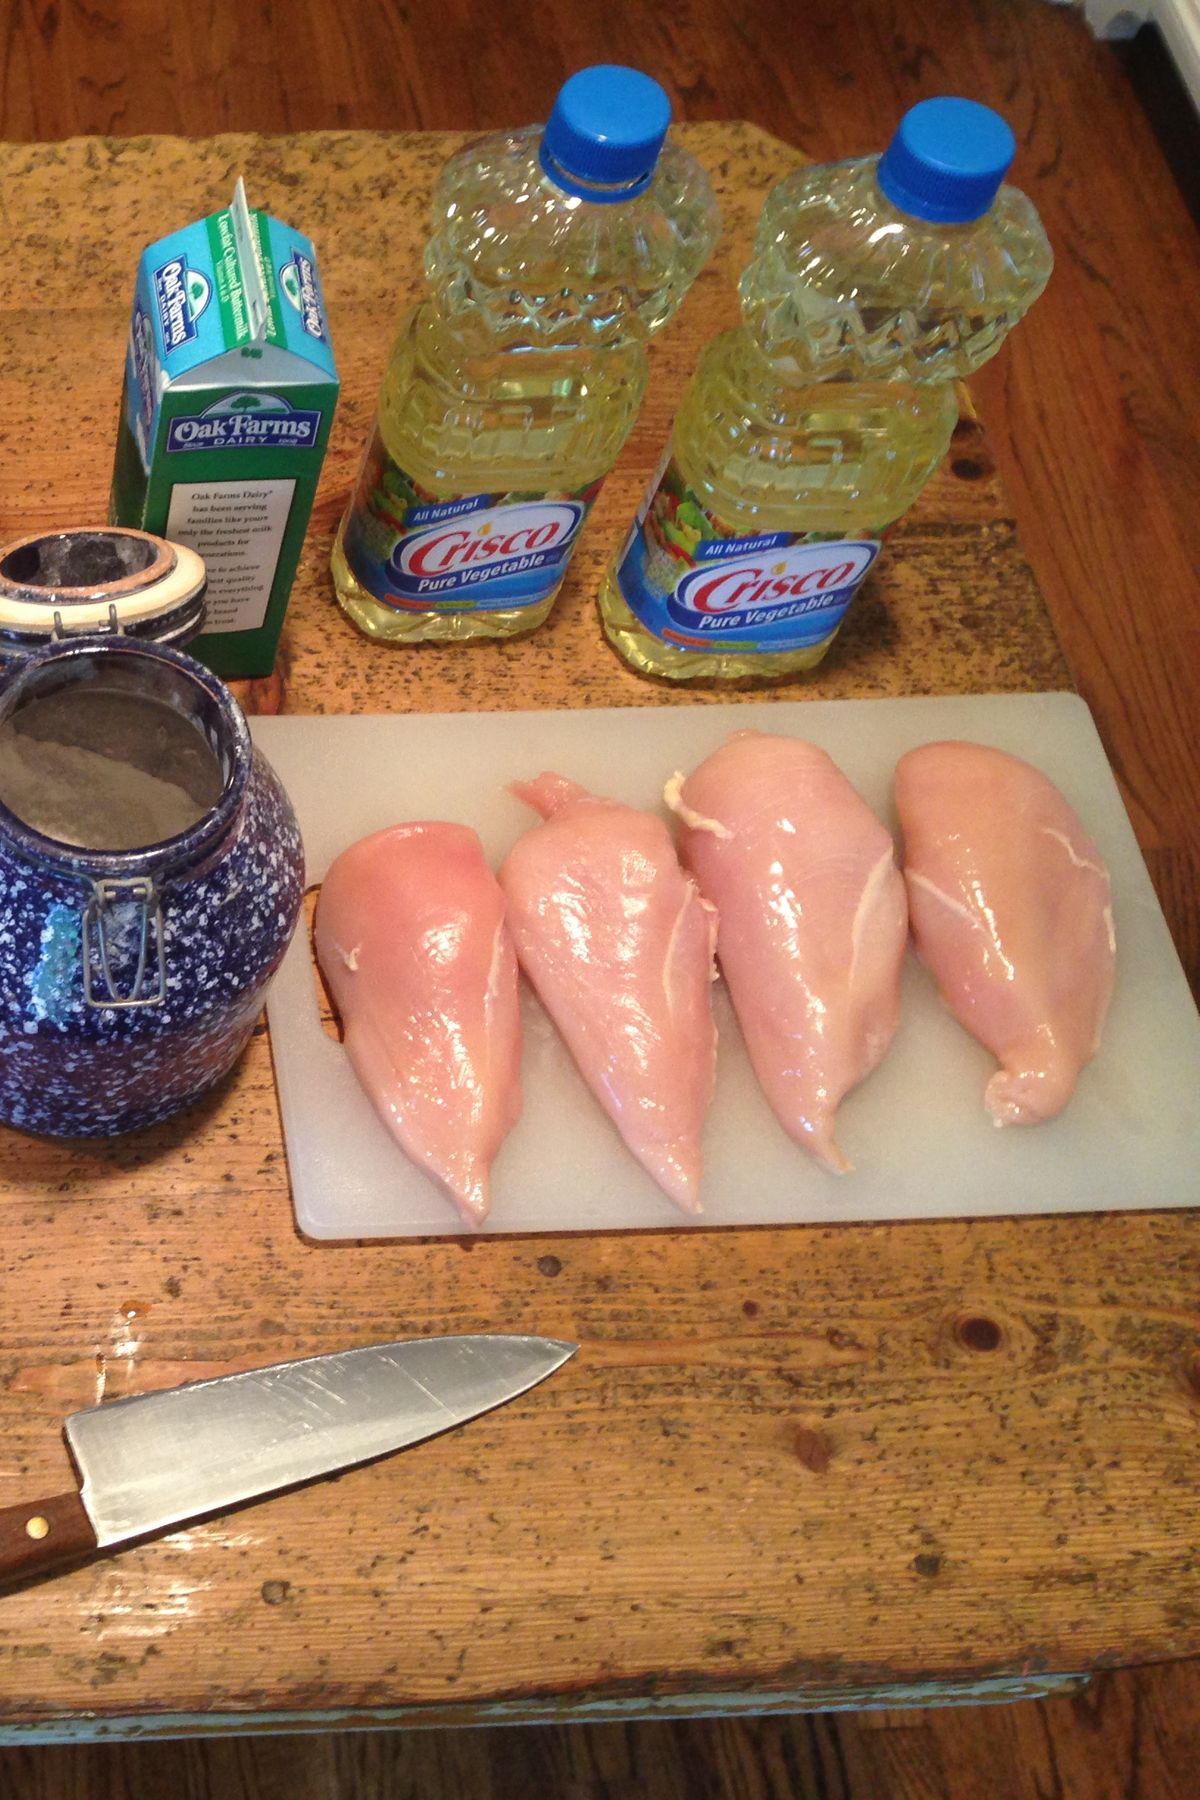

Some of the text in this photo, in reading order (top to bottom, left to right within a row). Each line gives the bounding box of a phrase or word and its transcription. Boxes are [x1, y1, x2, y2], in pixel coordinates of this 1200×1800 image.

[162, 262, 187, 346] Oak Farms
[174, 414, 311, 442] Oak Farms
[213, 436, 269, 445] DAIRY
[213, 492, 241, 500] Farms
[413, 498, 480, 522] All Natural
[409, 521, 561, 577] Crisco
[704, 535, 778, 557] All Natural
[417, 576, 457, 593] Pure
[460, 553, 546, 586] Vegetable
[693, 560, 856, 615] Crisco
[698, 614, 740, 630] Pure
[745, 594, 835, 624] Vegetable
